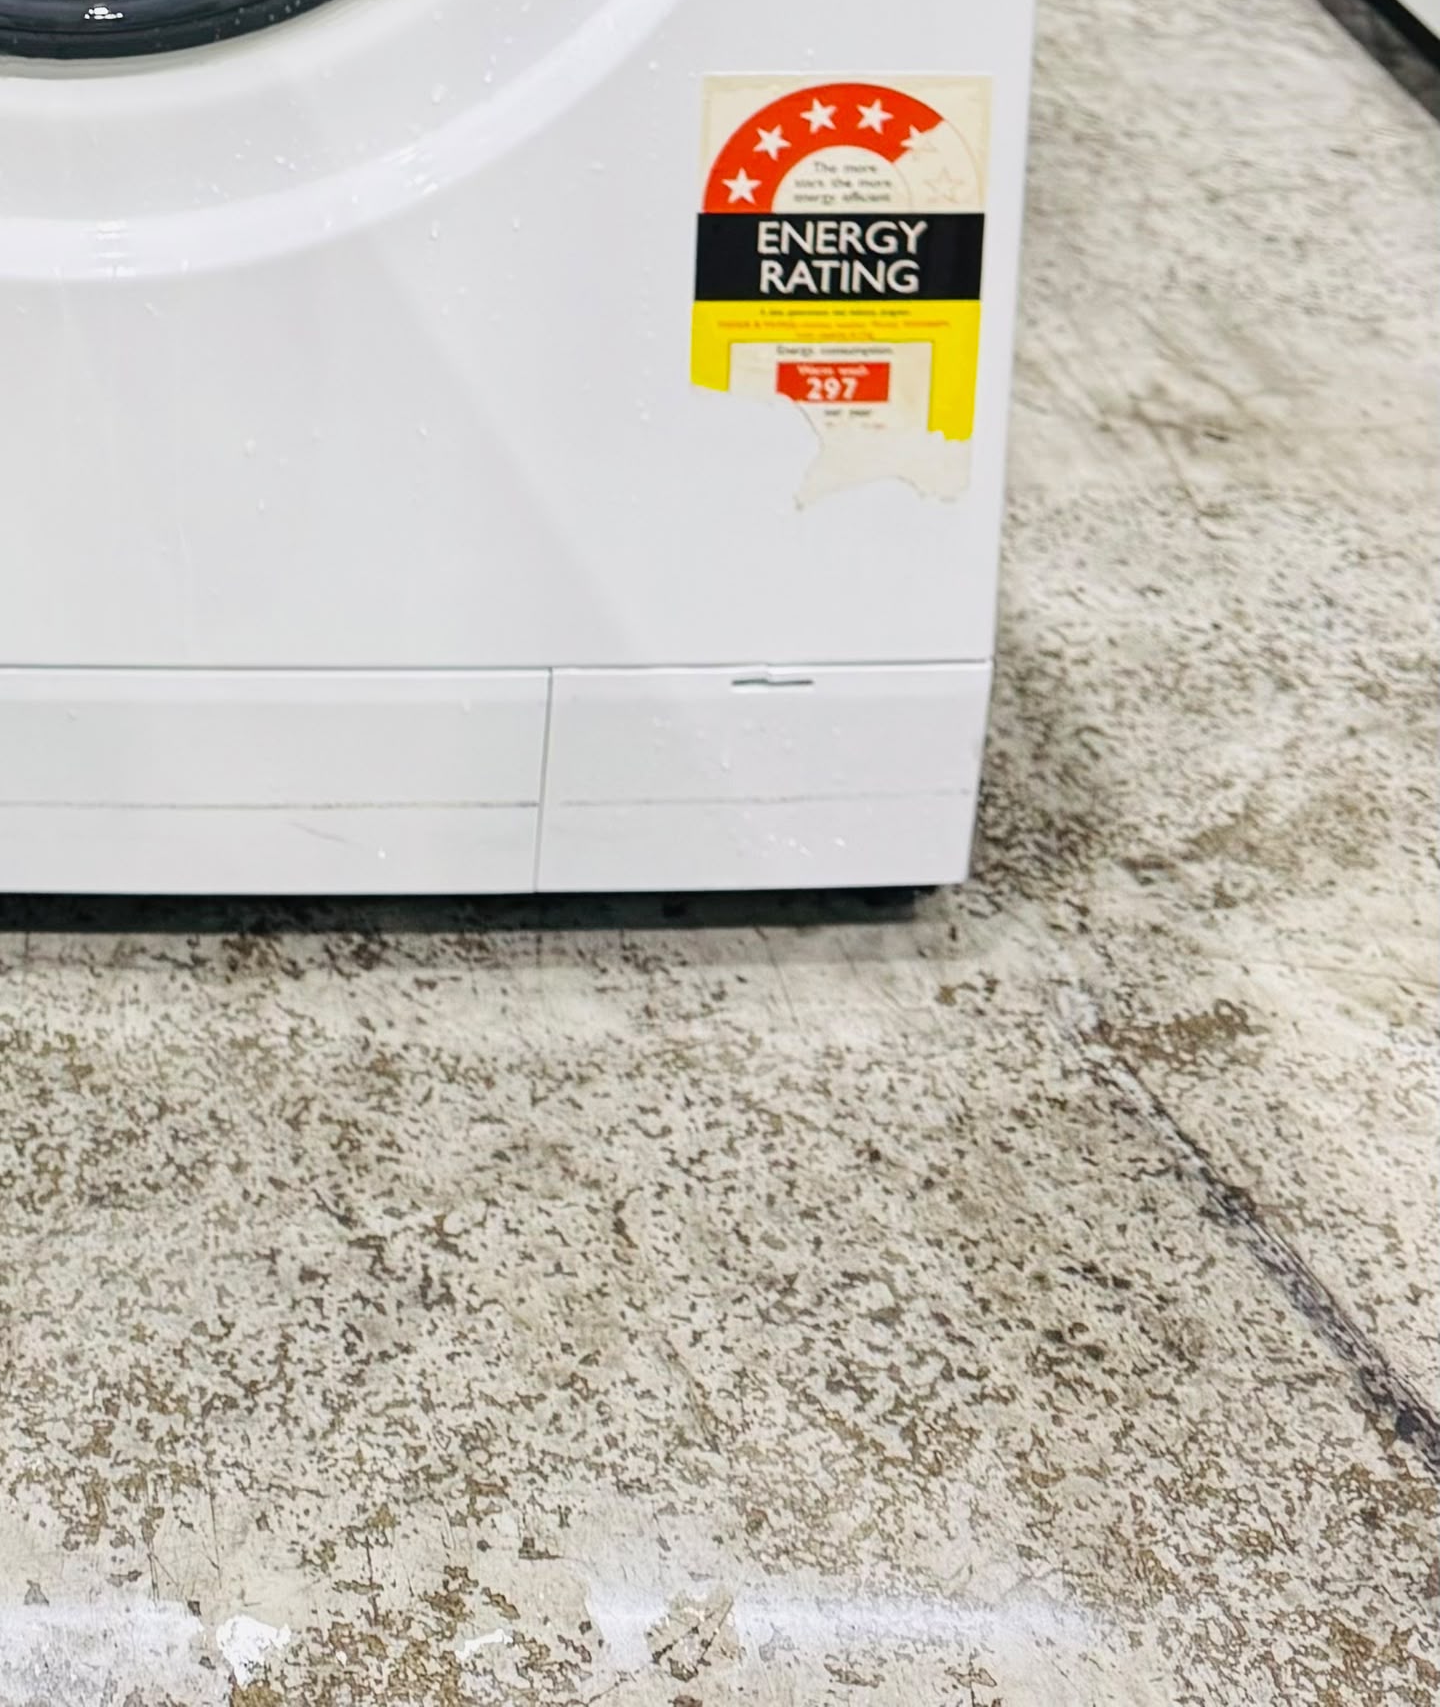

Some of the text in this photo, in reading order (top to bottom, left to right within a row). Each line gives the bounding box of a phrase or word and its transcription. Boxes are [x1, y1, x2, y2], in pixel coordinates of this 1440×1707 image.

[757, 220, 928, 255] ENERGY
[760, 259, 920, 295] RATING
[806, 377, 859, 400] 297
